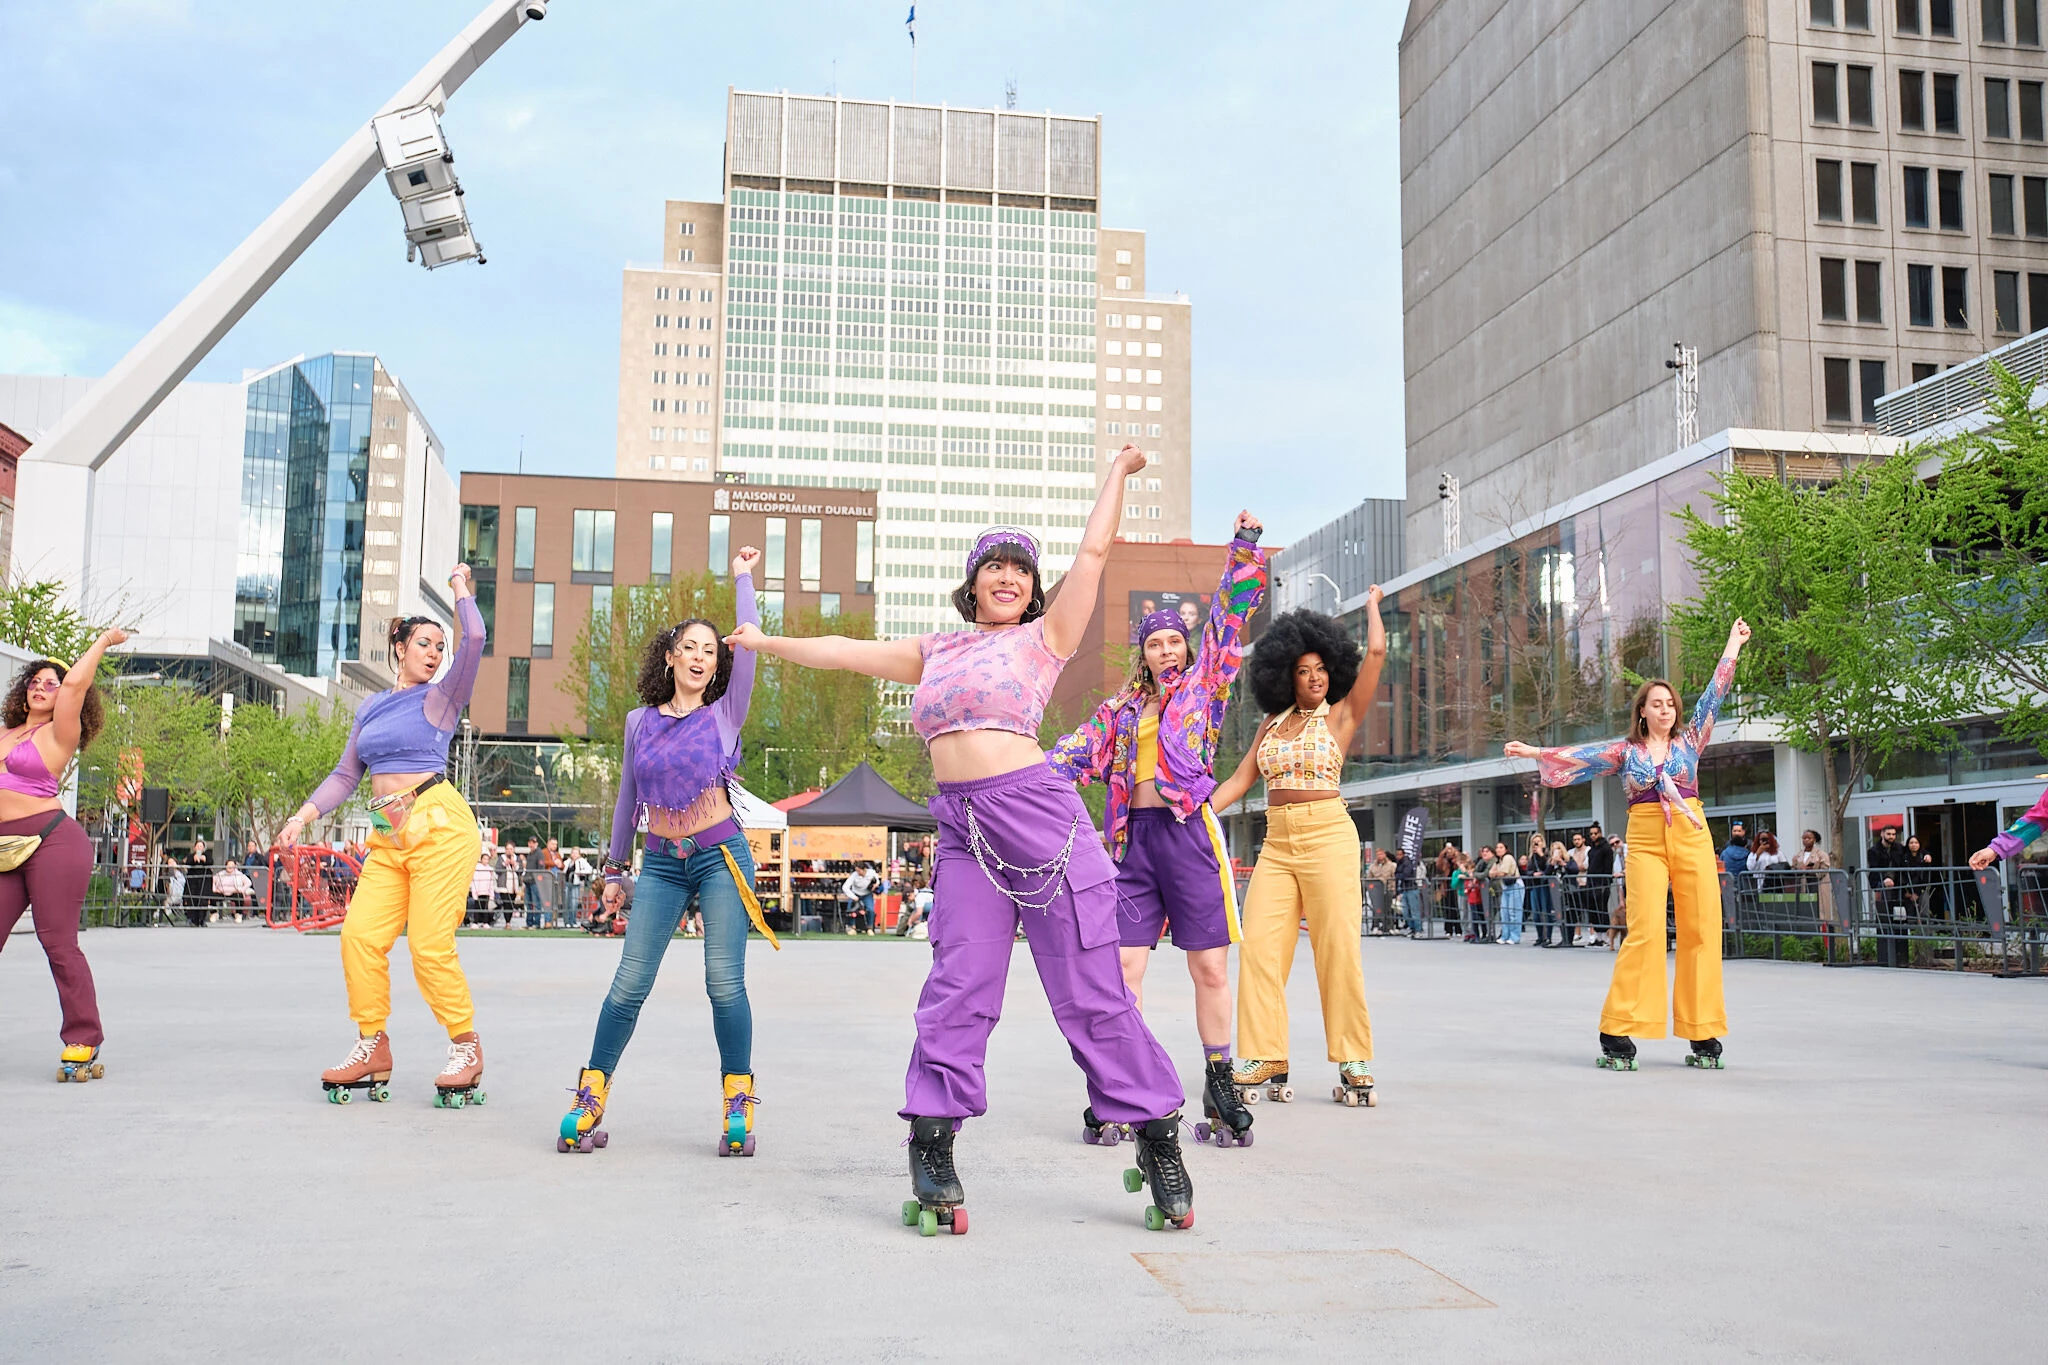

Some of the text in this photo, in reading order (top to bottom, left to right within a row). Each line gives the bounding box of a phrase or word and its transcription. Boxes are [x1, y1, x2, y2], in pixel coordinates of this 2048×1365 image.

[732, 490, 795, 502] MAISON DU
[731, 501, 874, 517] DÉVELOPPEMENT DURABLE
